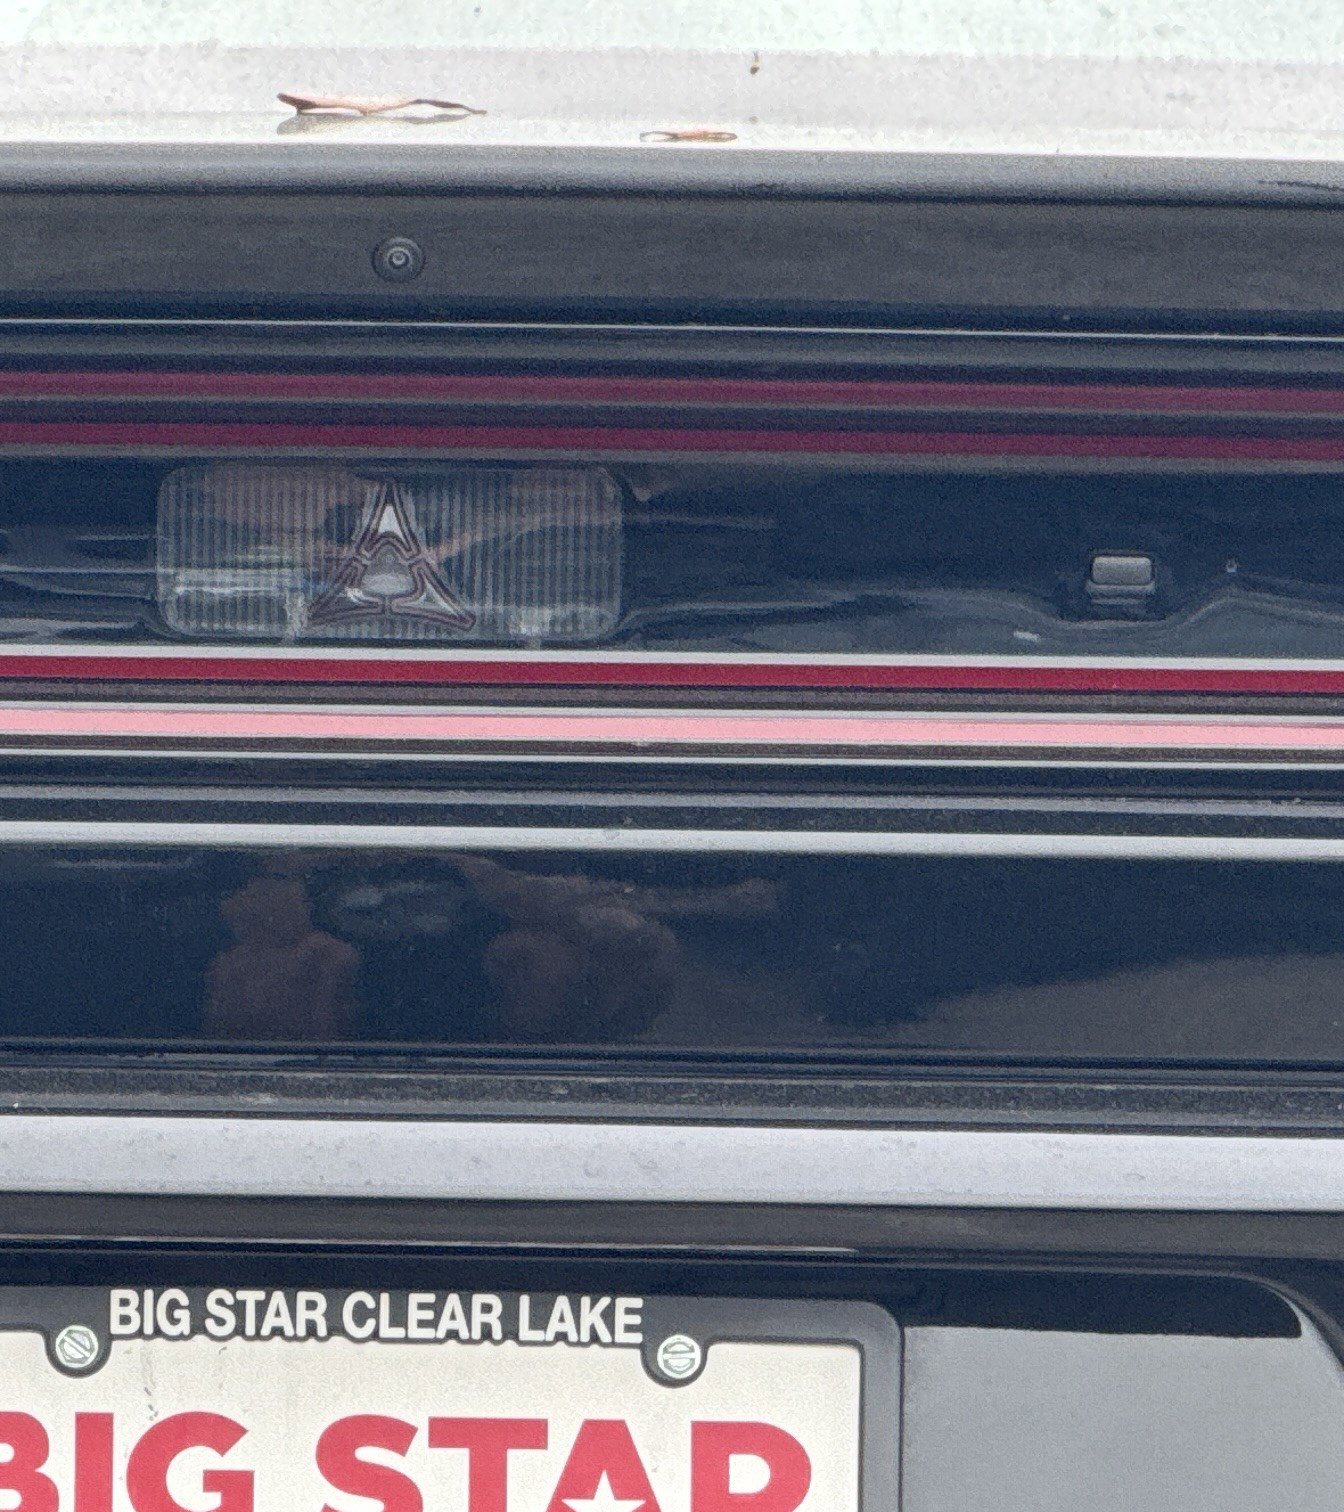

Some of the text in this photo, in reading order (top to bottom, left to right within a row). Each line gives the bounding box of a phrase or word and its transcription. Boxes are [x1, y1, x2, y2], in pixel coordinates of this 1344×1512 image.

[110, 1289, 643, 1343] BIG STAR CLEAR LAKE
